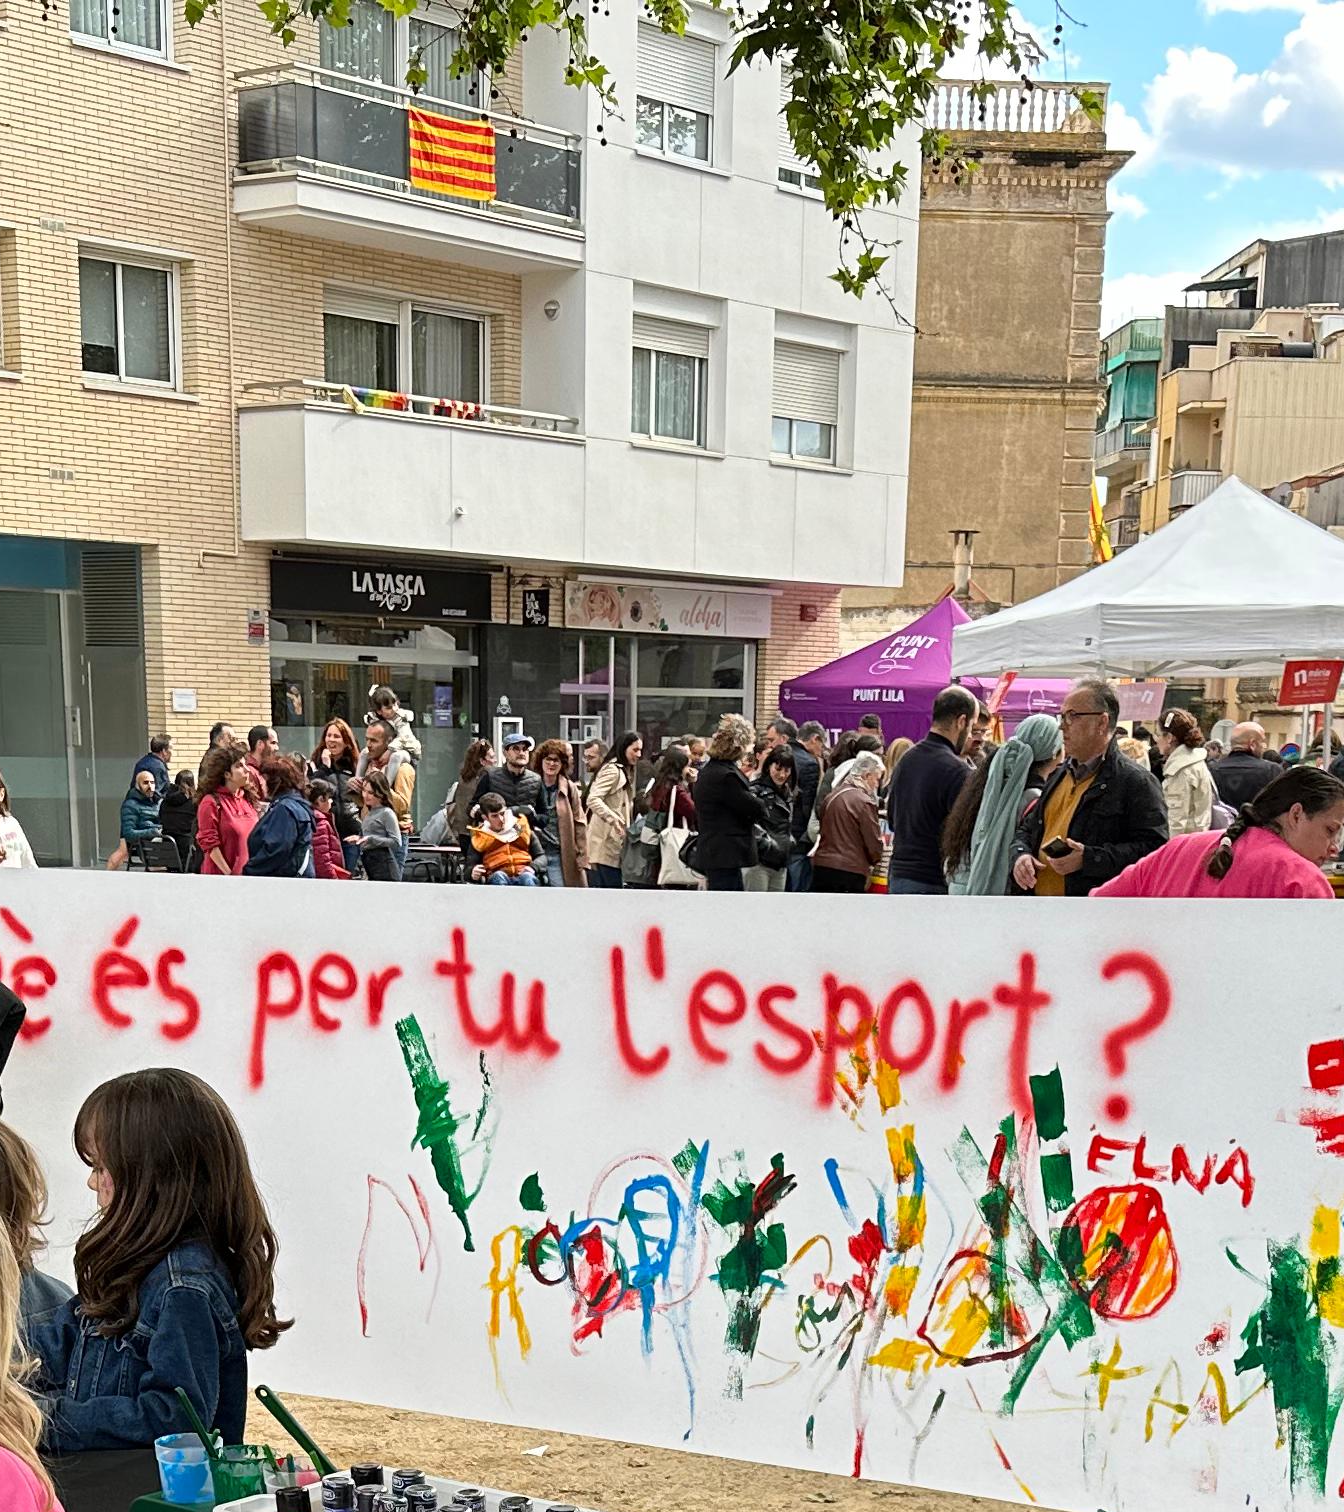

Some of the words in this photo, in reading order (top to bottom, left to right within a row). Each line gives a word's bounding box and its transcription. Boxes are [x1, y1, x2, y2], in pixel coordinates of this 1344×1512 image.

[352, 570, 374, 593] LA
[375, 572, 426, 597] TASCA
[679, 594, 723, 631] aloha
[890, 635, 939, 649] PUNT
[880, 647, 919, 659] LILA
[853, 688, 881, 702] PUNT
[882, 690, 905, 702] LILA
[87, 910, 205, 1045] és
[245, 945, 405, 1095] per
[431, 922, 563, 1061] tu
[607, 920, 1053, 1115] l'esport
